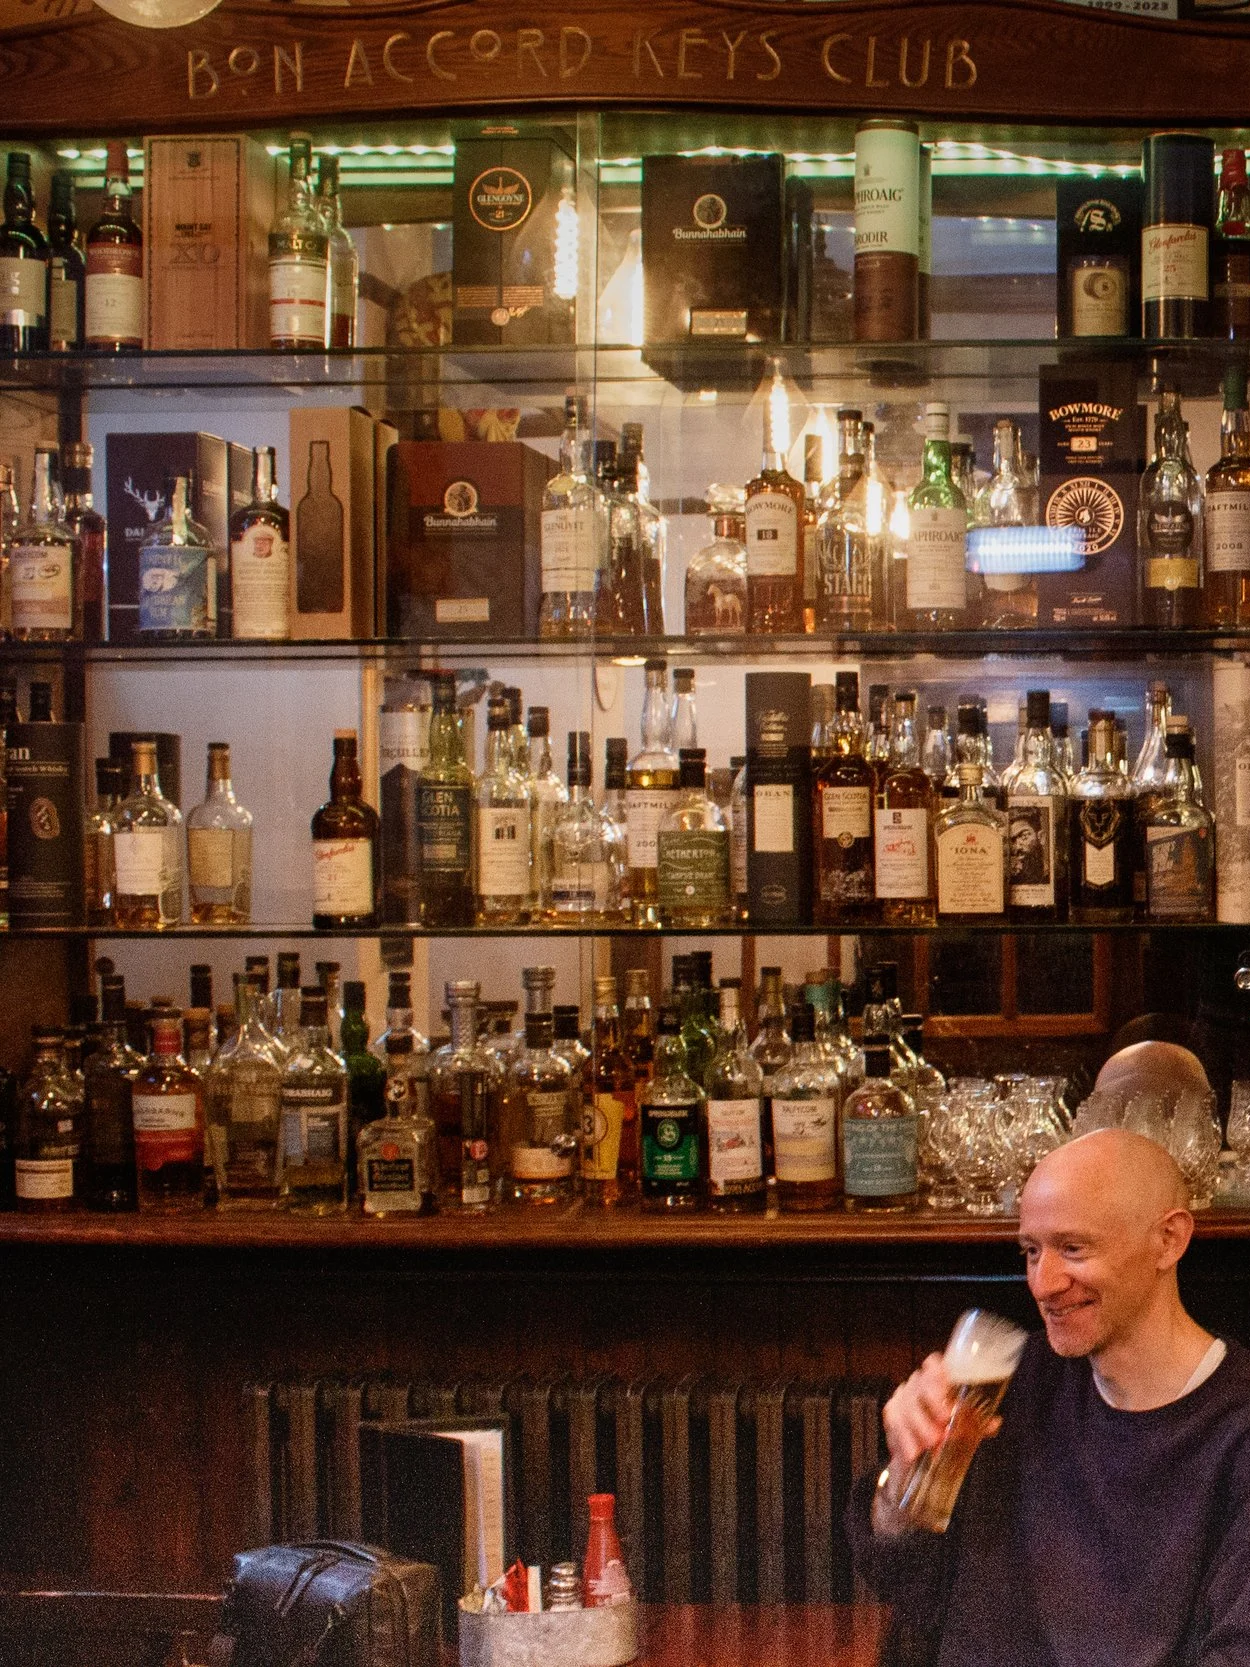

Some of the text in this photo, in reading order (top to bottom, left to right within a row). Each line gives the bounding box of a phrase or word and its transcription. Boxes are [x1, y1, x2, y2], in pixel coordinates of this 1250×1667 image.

[188, 26, 977, 99] BON ACCORD KEYS CLUB
[672, 227, 747, 241] Bunnahabhain
[1049, 402, 1123, 421] BOWMORE
[636, 840, 658, 848] 200
